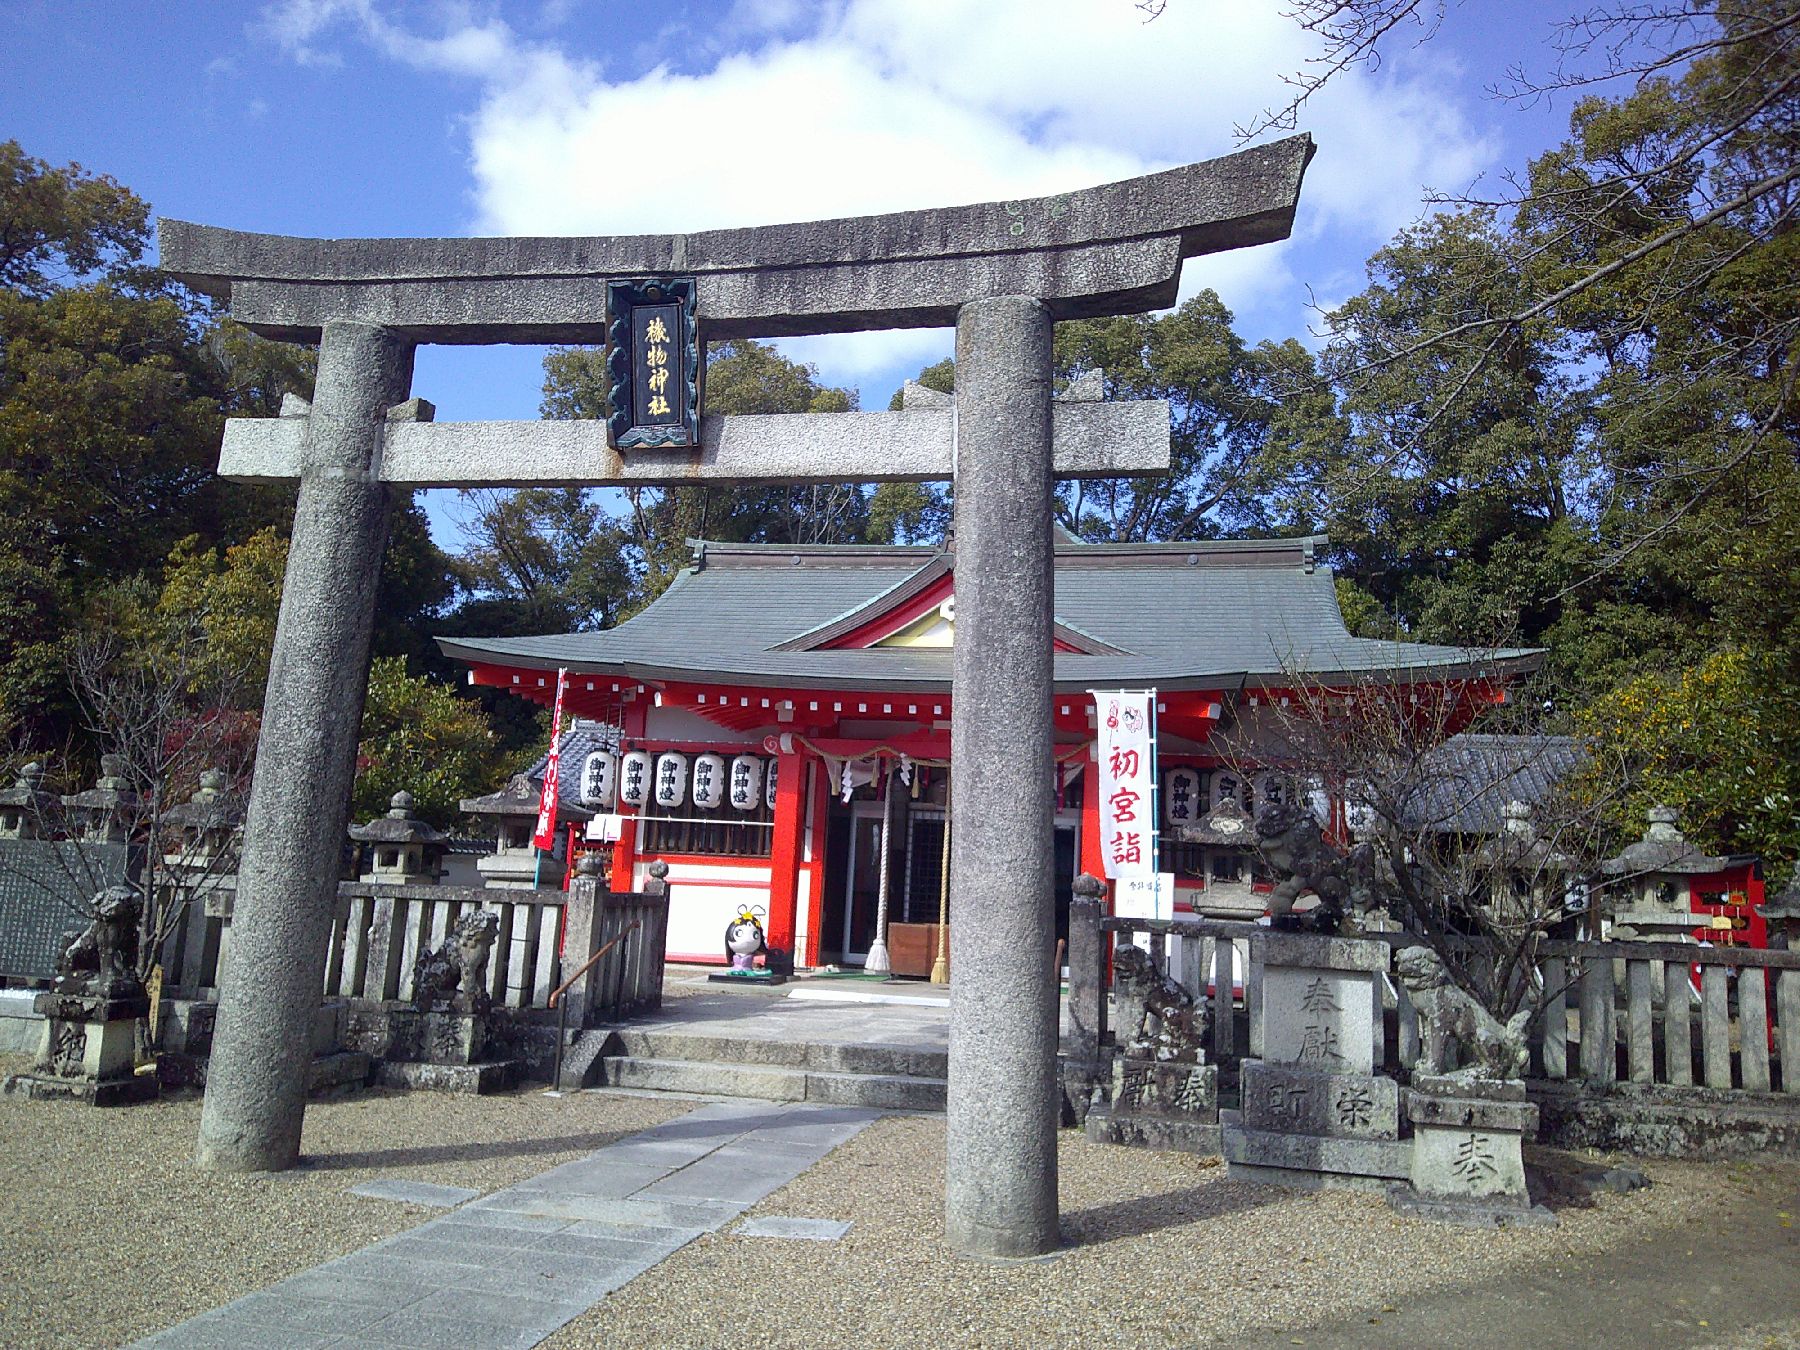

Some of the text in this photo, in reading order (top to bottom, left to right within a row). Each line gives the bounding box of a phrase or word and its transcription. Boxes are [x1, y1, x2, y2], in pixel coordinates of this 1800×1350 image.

[587, 757, 605, 799] 御神燈
[625, 758, 644, 800] 御神燈
[659, 758, 678, 802] 御神燈
[695, 759, 713, 803] 御神燈
[732, 760, 751, 804] 御神燈
[1108, 746, 1141, 865] 初宮詣
[1452, 1133, 1498, 1189] 奉
